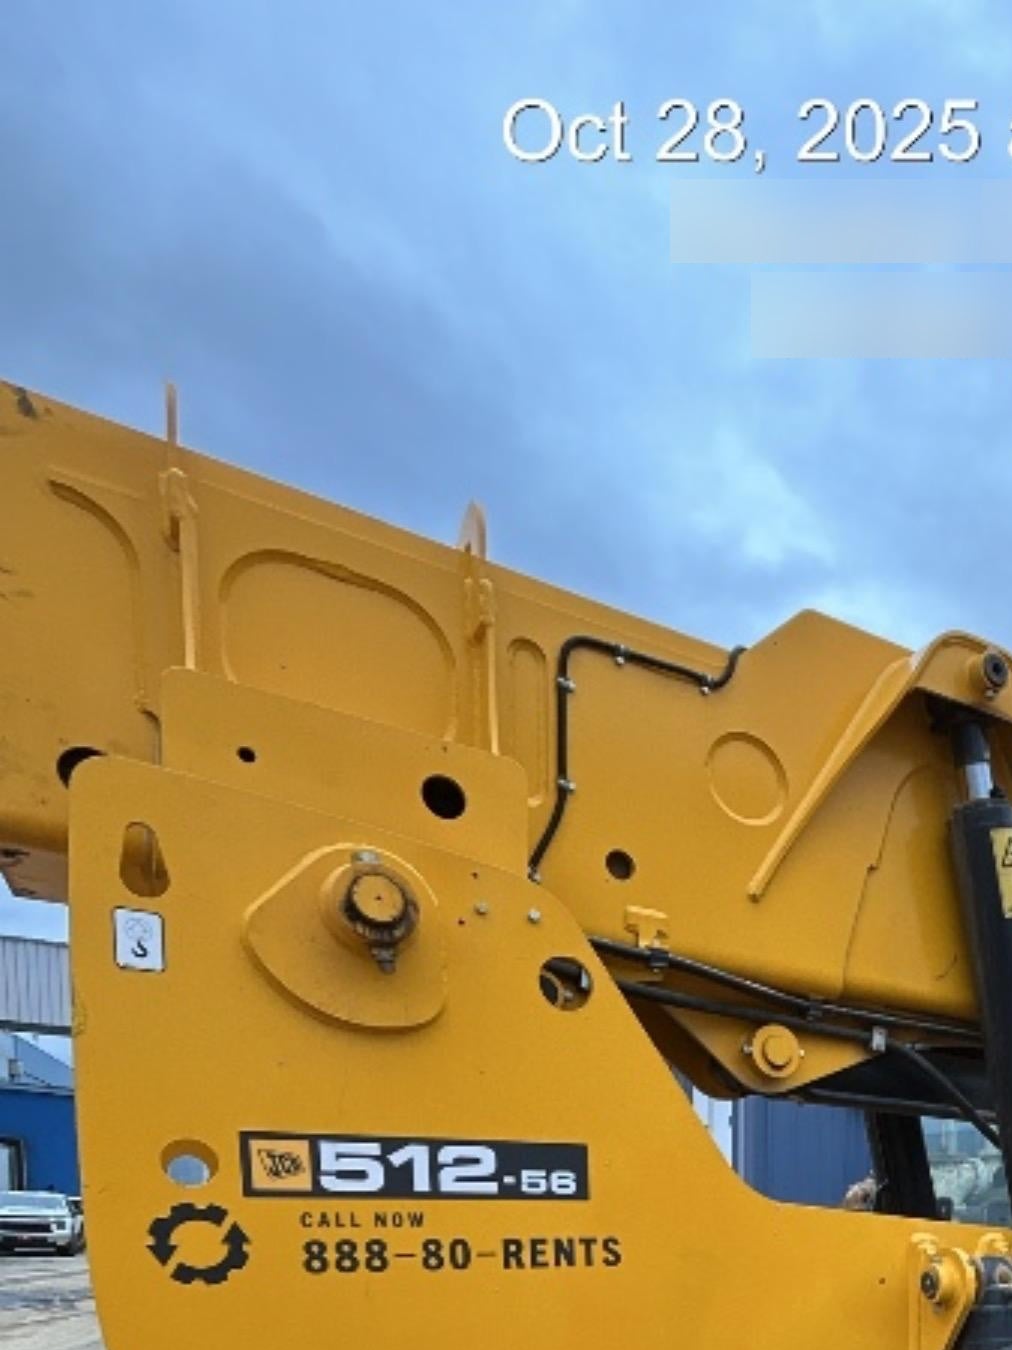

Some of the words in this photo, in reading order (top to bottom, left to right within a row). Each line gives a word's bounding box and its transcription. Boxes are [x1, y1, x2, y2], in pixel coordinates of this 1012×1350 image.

[317, 1139, 578, 1196] 512-56
[300, 1211, 362, 1229] CALL
[374, 1210, 426, 1228] NOW
[302, 1236, 623, 1275] 888-80-RENTS
